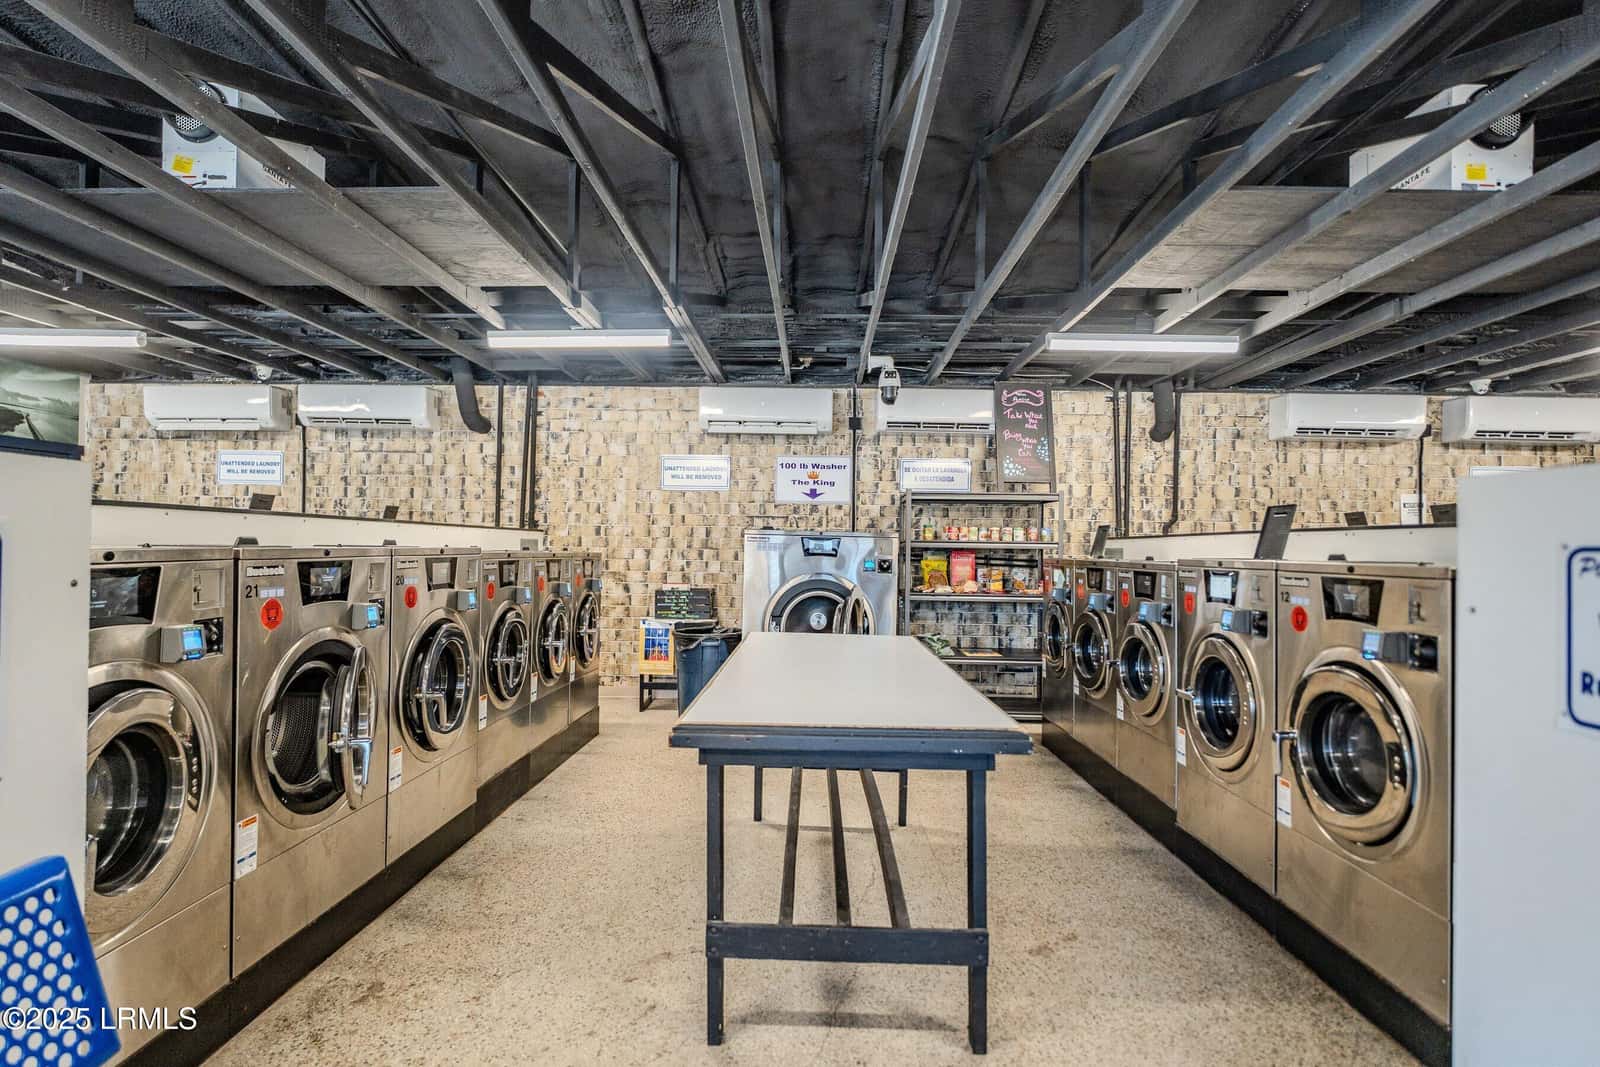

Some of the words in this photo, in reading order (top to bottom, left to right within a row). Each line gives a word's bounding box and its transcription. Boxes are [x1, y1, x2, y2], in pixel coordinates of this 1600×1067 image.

[779, 462, 797, 470] 100
[245, 584, 258, 599] 21
[1280, 591, 1290, 603] 12
